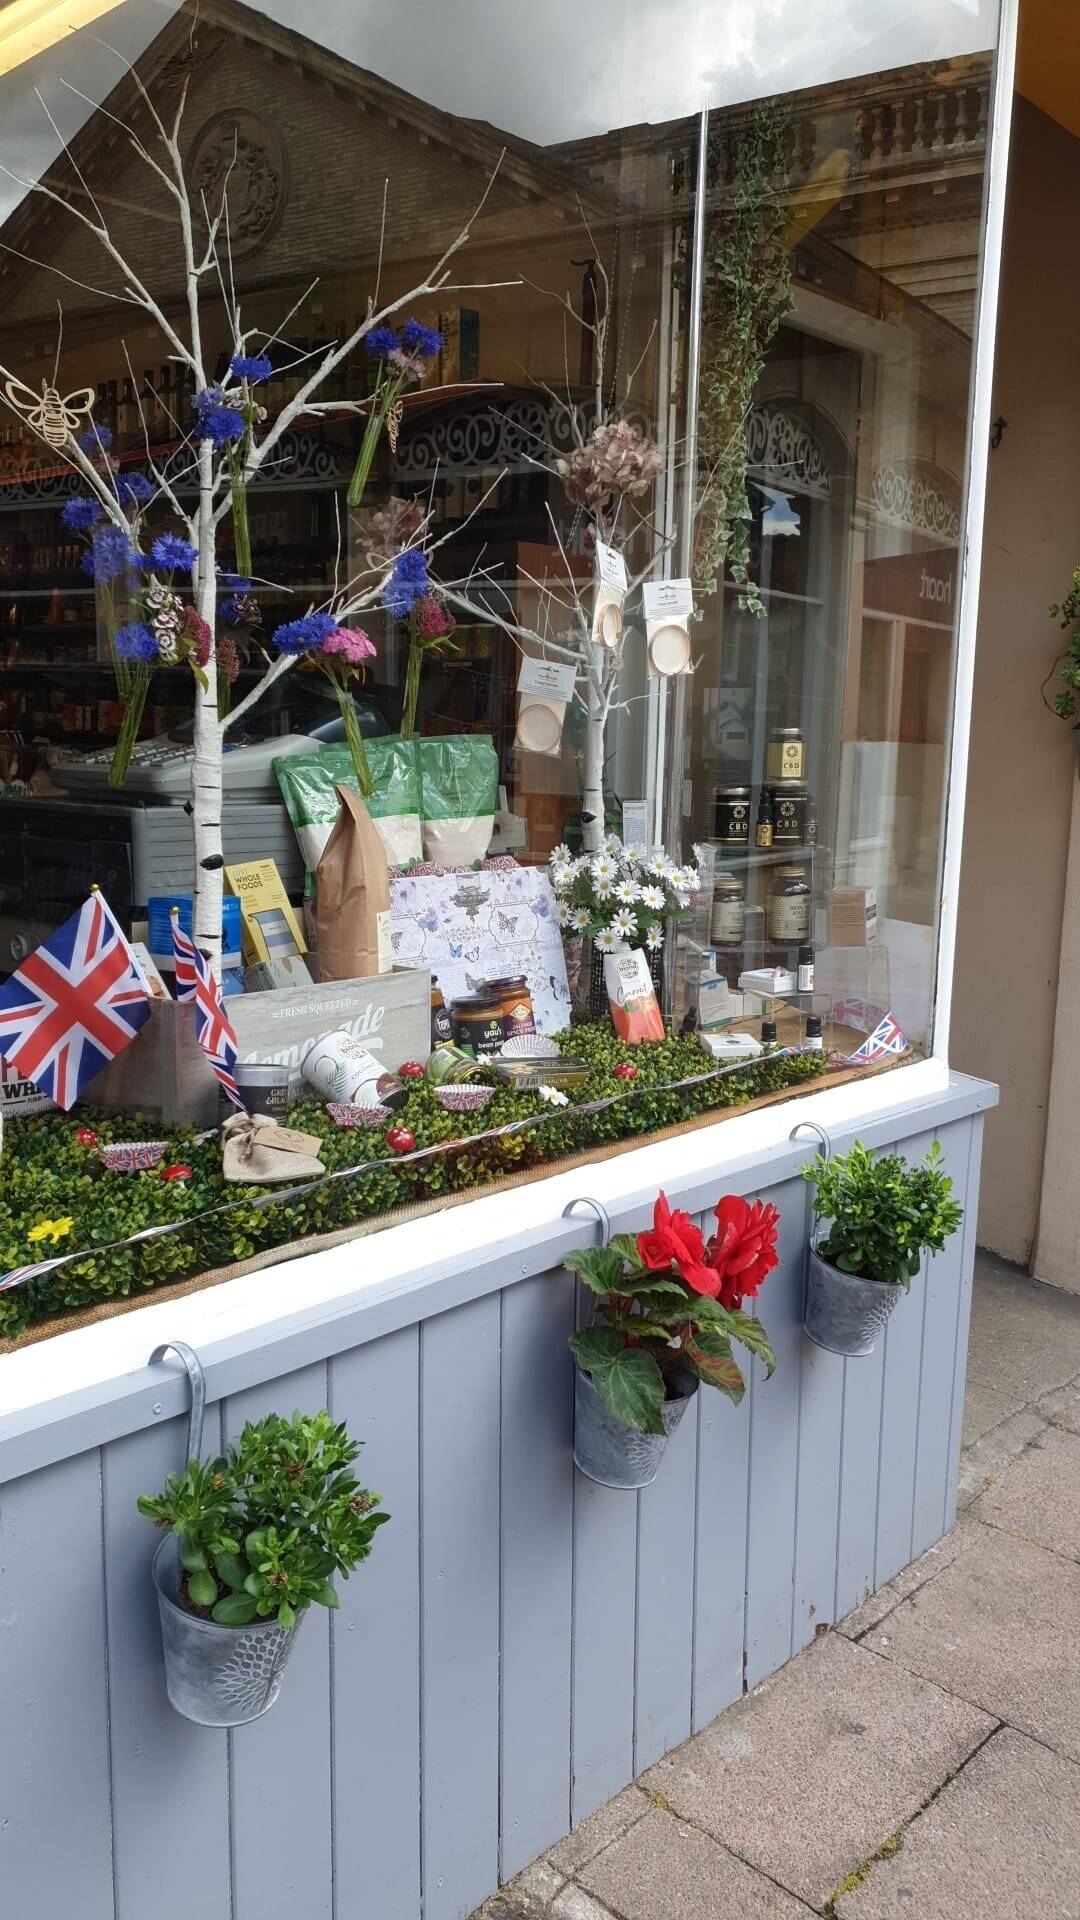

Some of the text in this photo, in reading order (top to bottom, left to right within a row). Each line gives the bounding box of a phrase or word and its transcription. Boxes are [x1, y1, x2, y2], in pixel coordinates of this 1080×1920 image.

[776, 820, 798, 828] CBD
[234, 873, 261, 884] WHOLE
[237, 880, 263, 891] FOODS
[280, 999, 352, 1018] FRESH SQUEEZED
